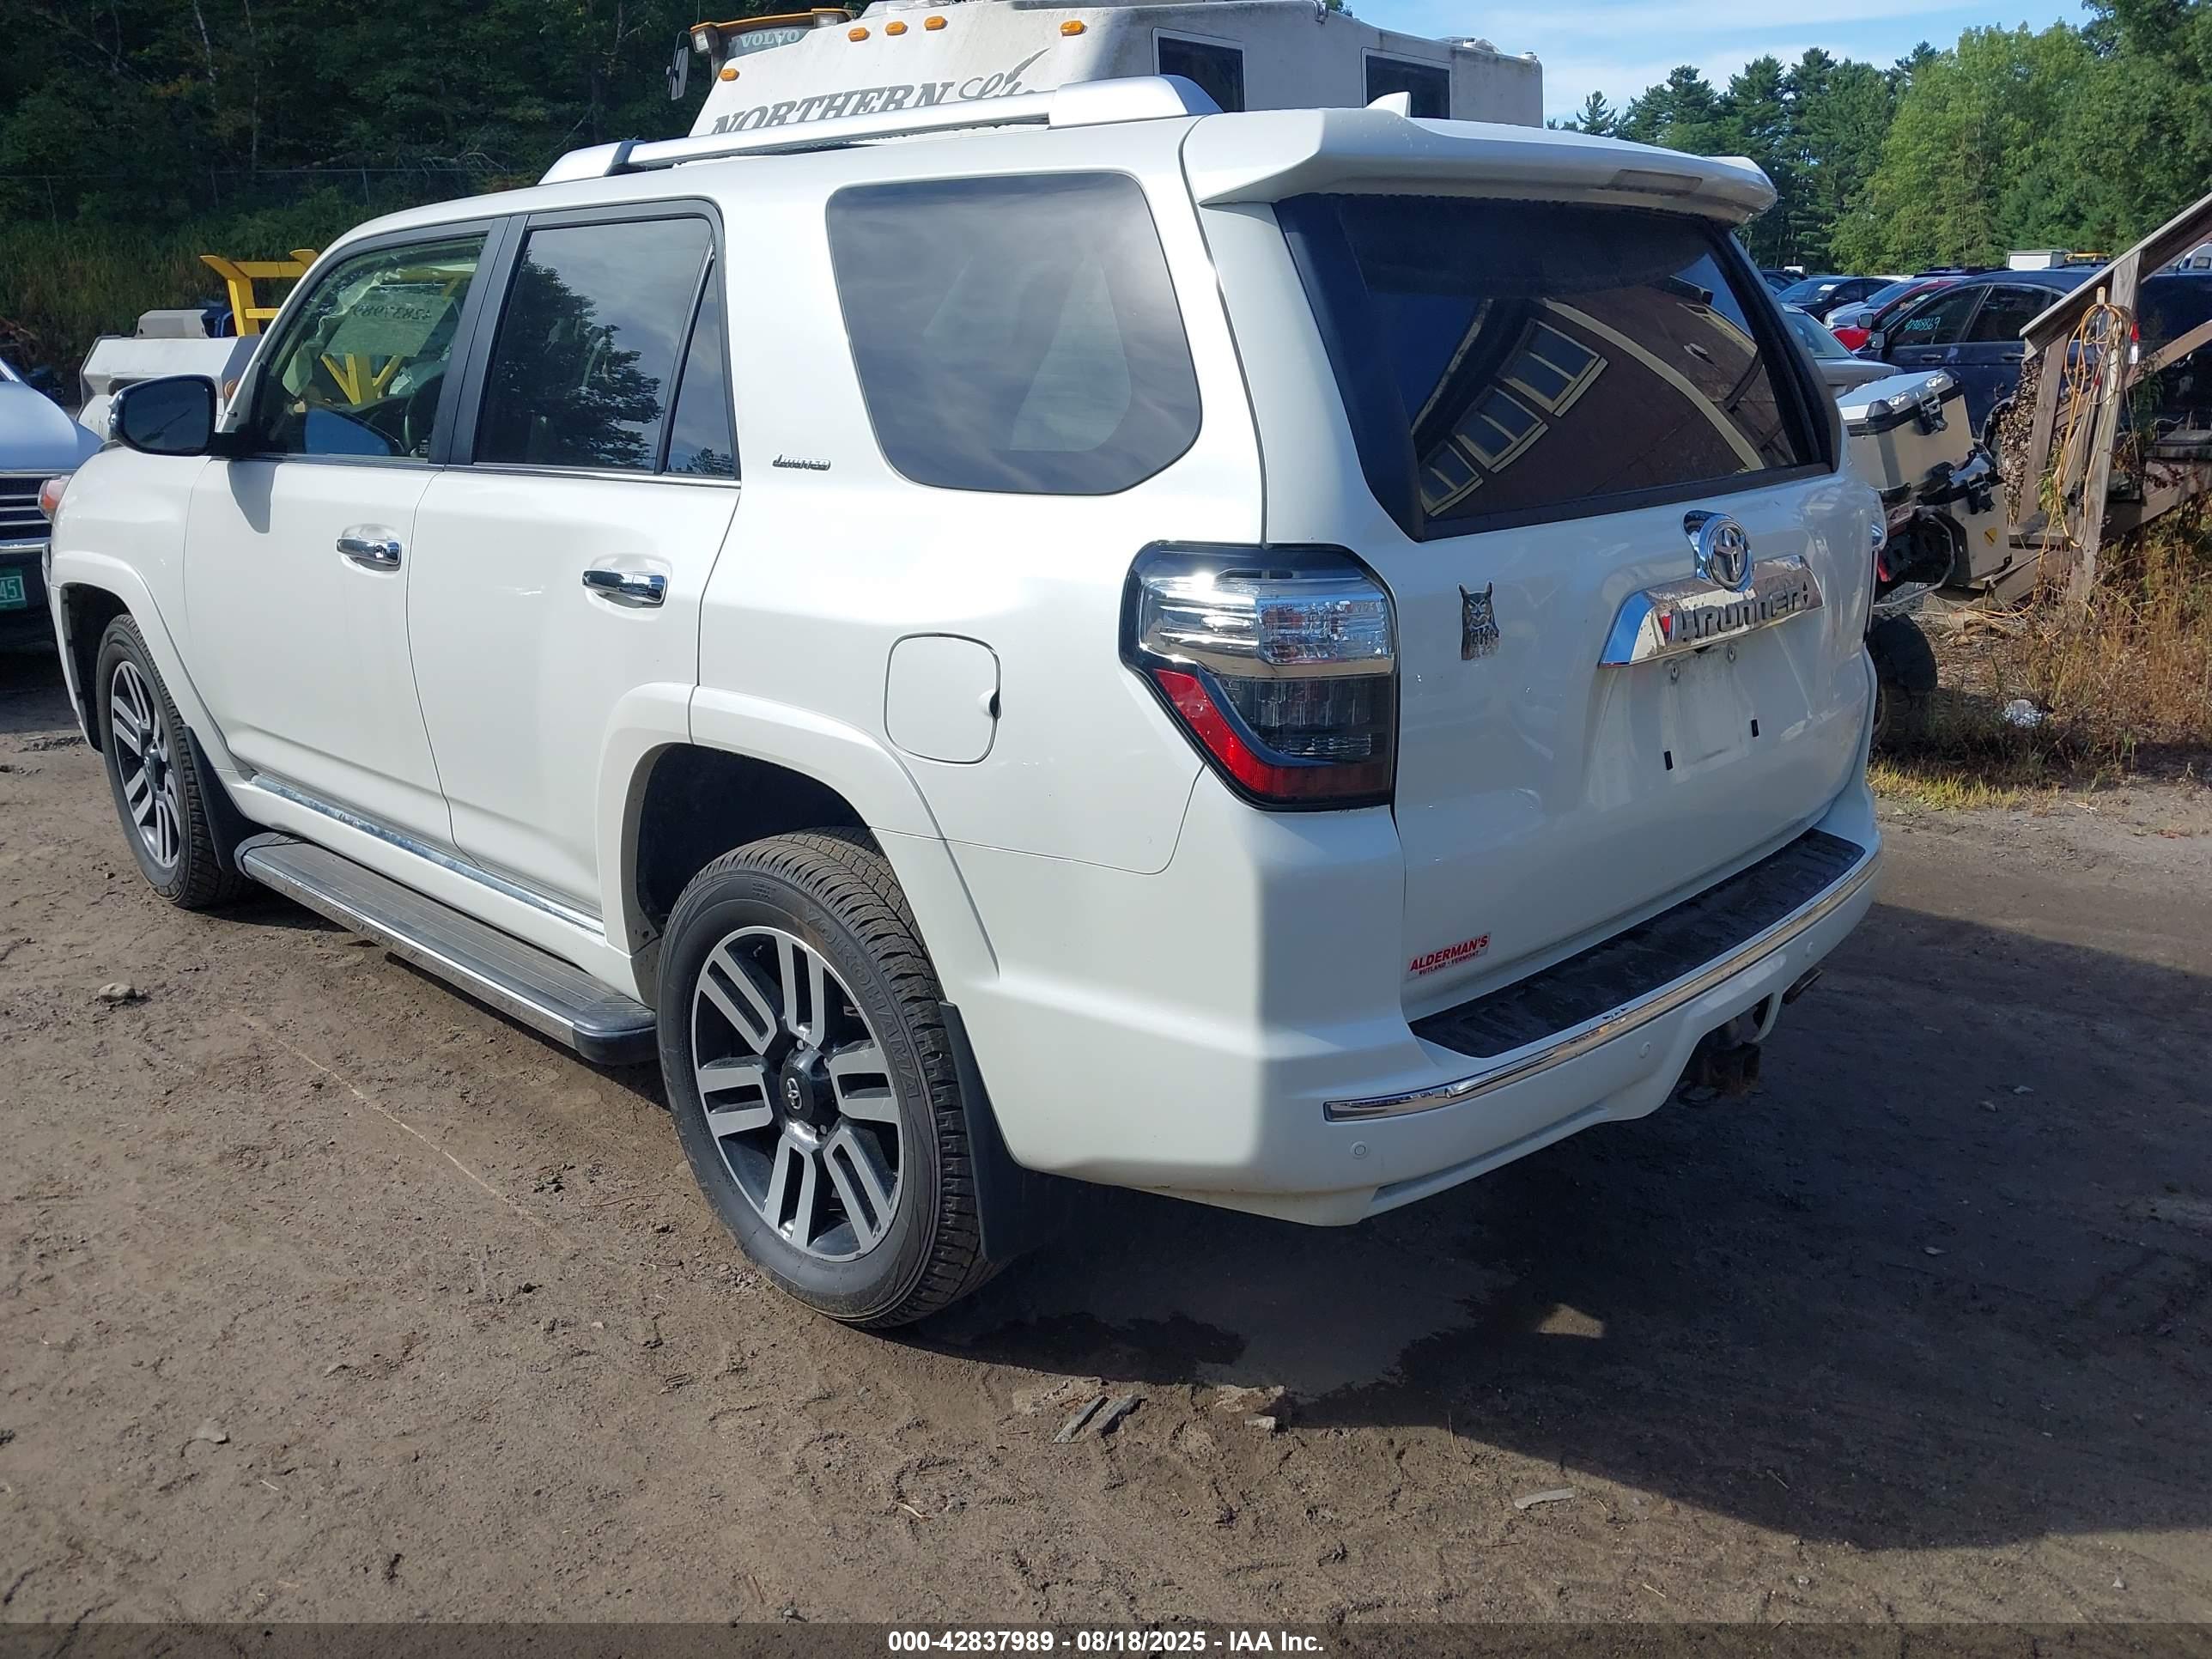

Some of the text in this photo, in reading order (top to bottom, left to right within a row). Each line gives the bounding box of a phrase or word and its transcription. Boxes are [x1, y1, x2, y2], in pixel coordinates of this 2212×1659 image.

[741, 30, 800, 48] VOLVO
[1410, 935, 1488, 971] ALDERMAN'S
[807, 904, 921, 1099] YOKOHAMA
